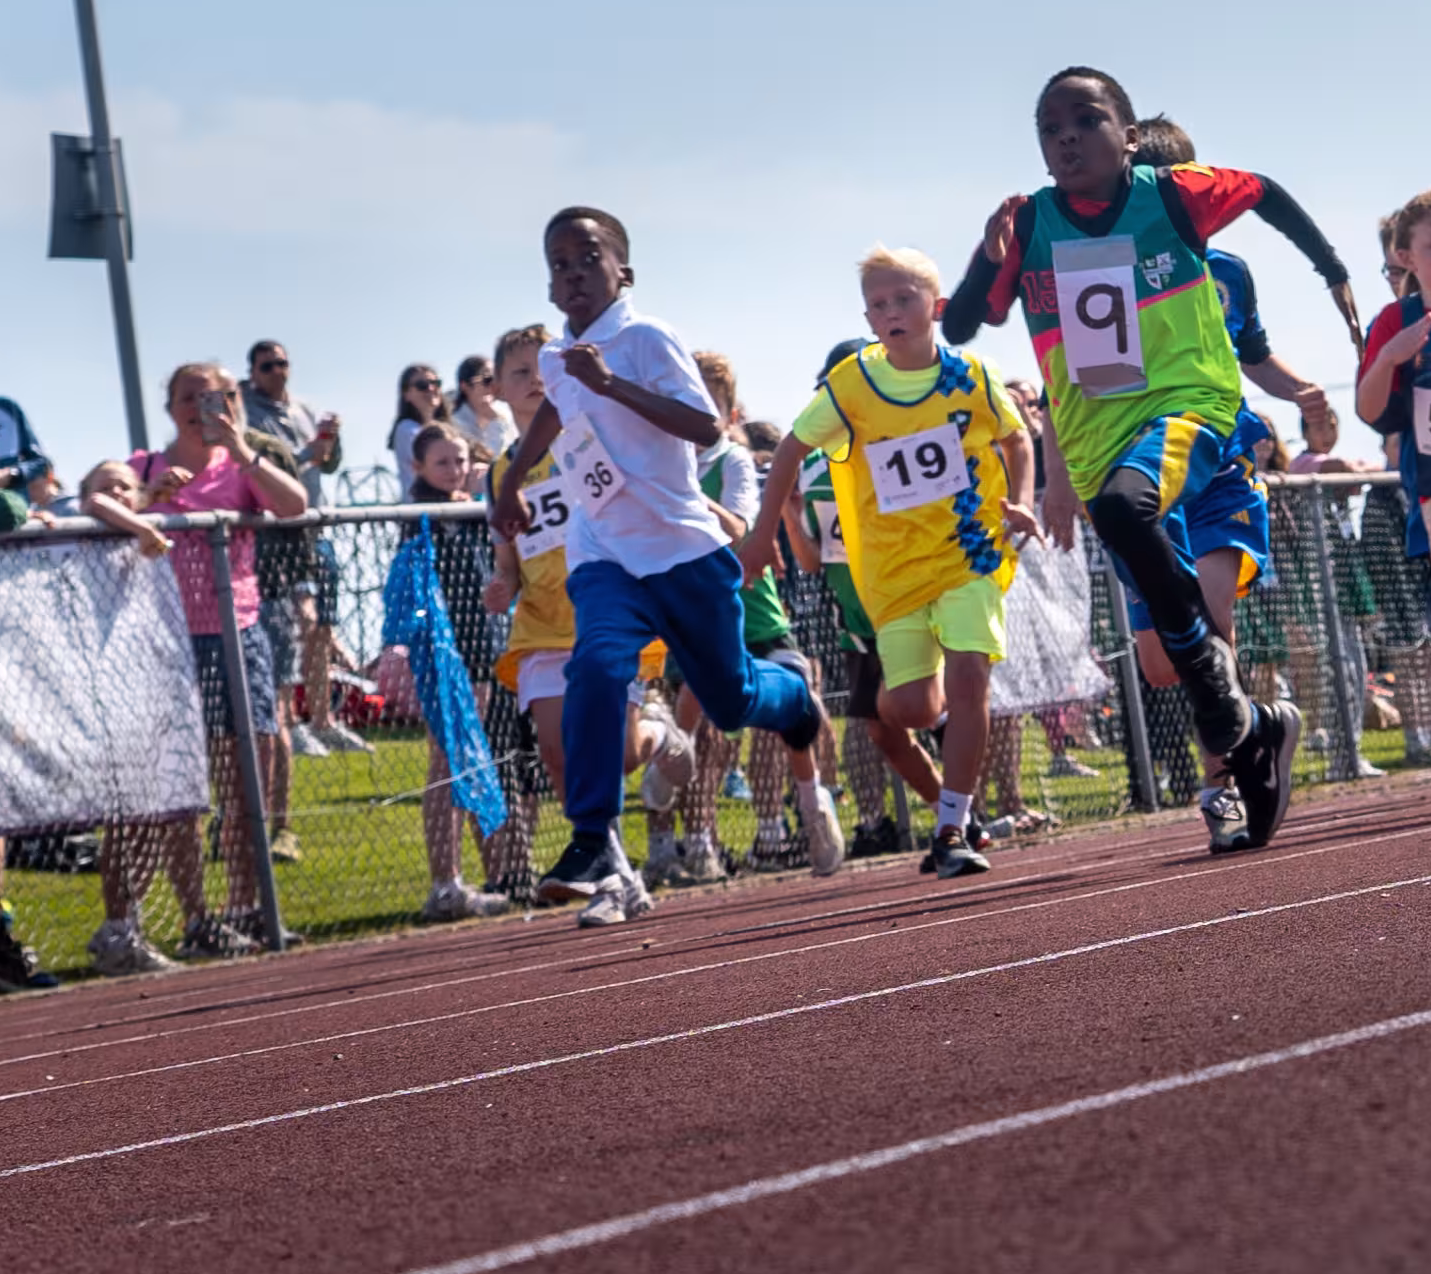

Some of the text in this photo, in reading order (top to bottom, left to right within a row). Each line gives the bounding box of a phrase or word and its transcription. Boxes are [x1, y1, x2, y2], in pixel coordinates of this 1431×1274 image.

[1075, 282, 1129, 355] 9
[583, 460, 614, 499] 36
[885, 441, 947, 487] 19
